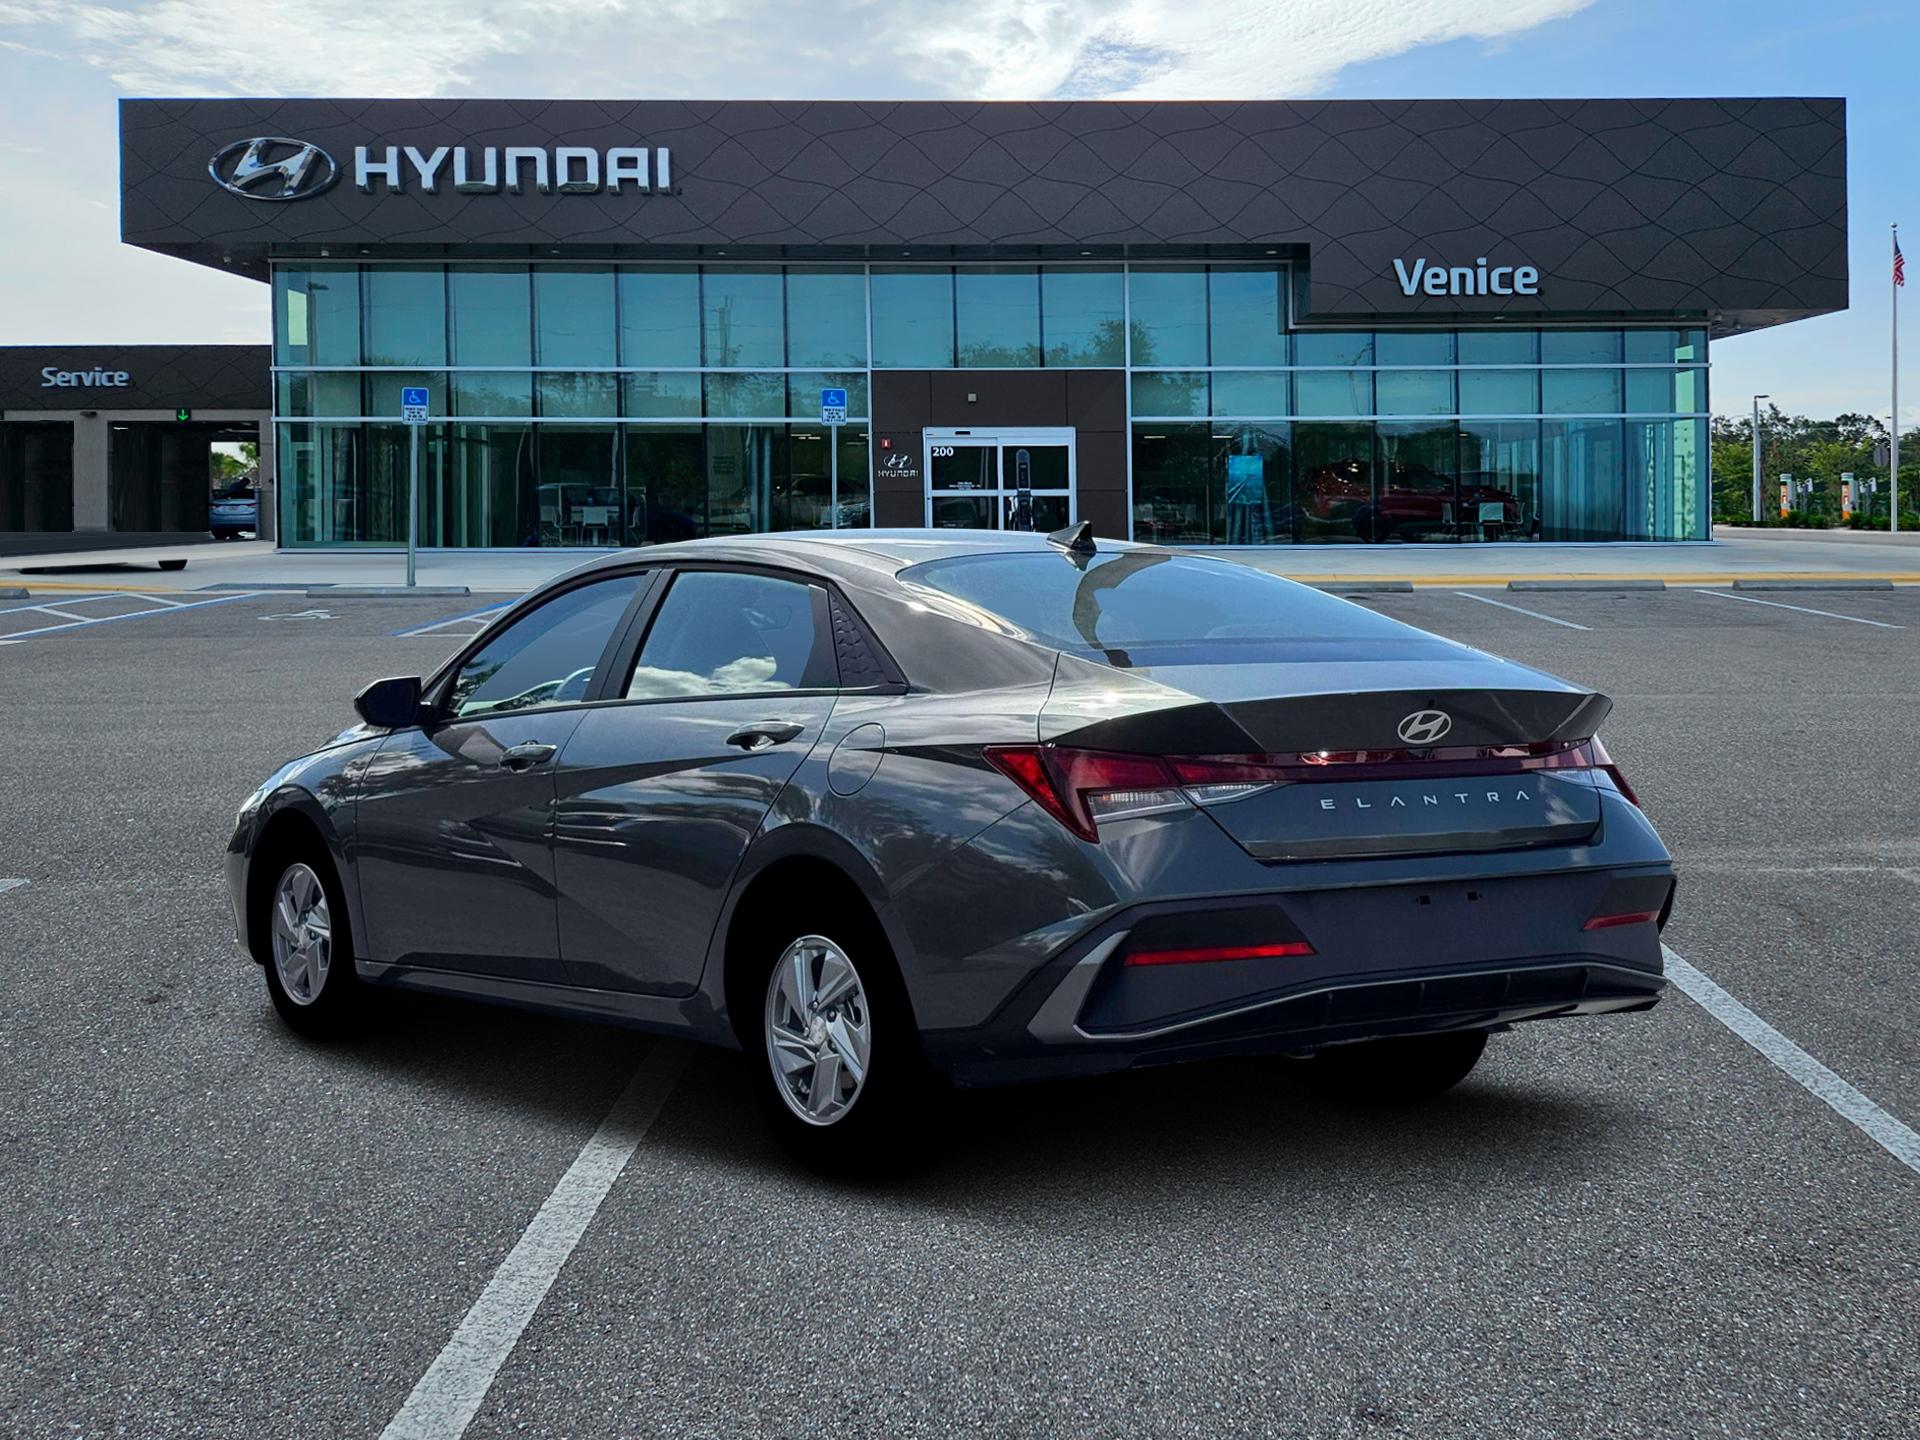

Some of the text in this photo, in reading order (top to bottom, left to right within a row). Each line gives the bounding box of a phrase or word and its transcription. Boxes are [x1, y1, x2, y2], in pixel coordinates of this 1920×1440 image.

[354, 146, 672, 194] HYUNDAI
[1393, 257, 1539, 296] Venice
[41, 366, 130, 387] Service
[932, 446, 954, 457] 200
[877, 469, 919, 478] HYUNDAI
[1320, 790, 1530, 810] ELANTRA
